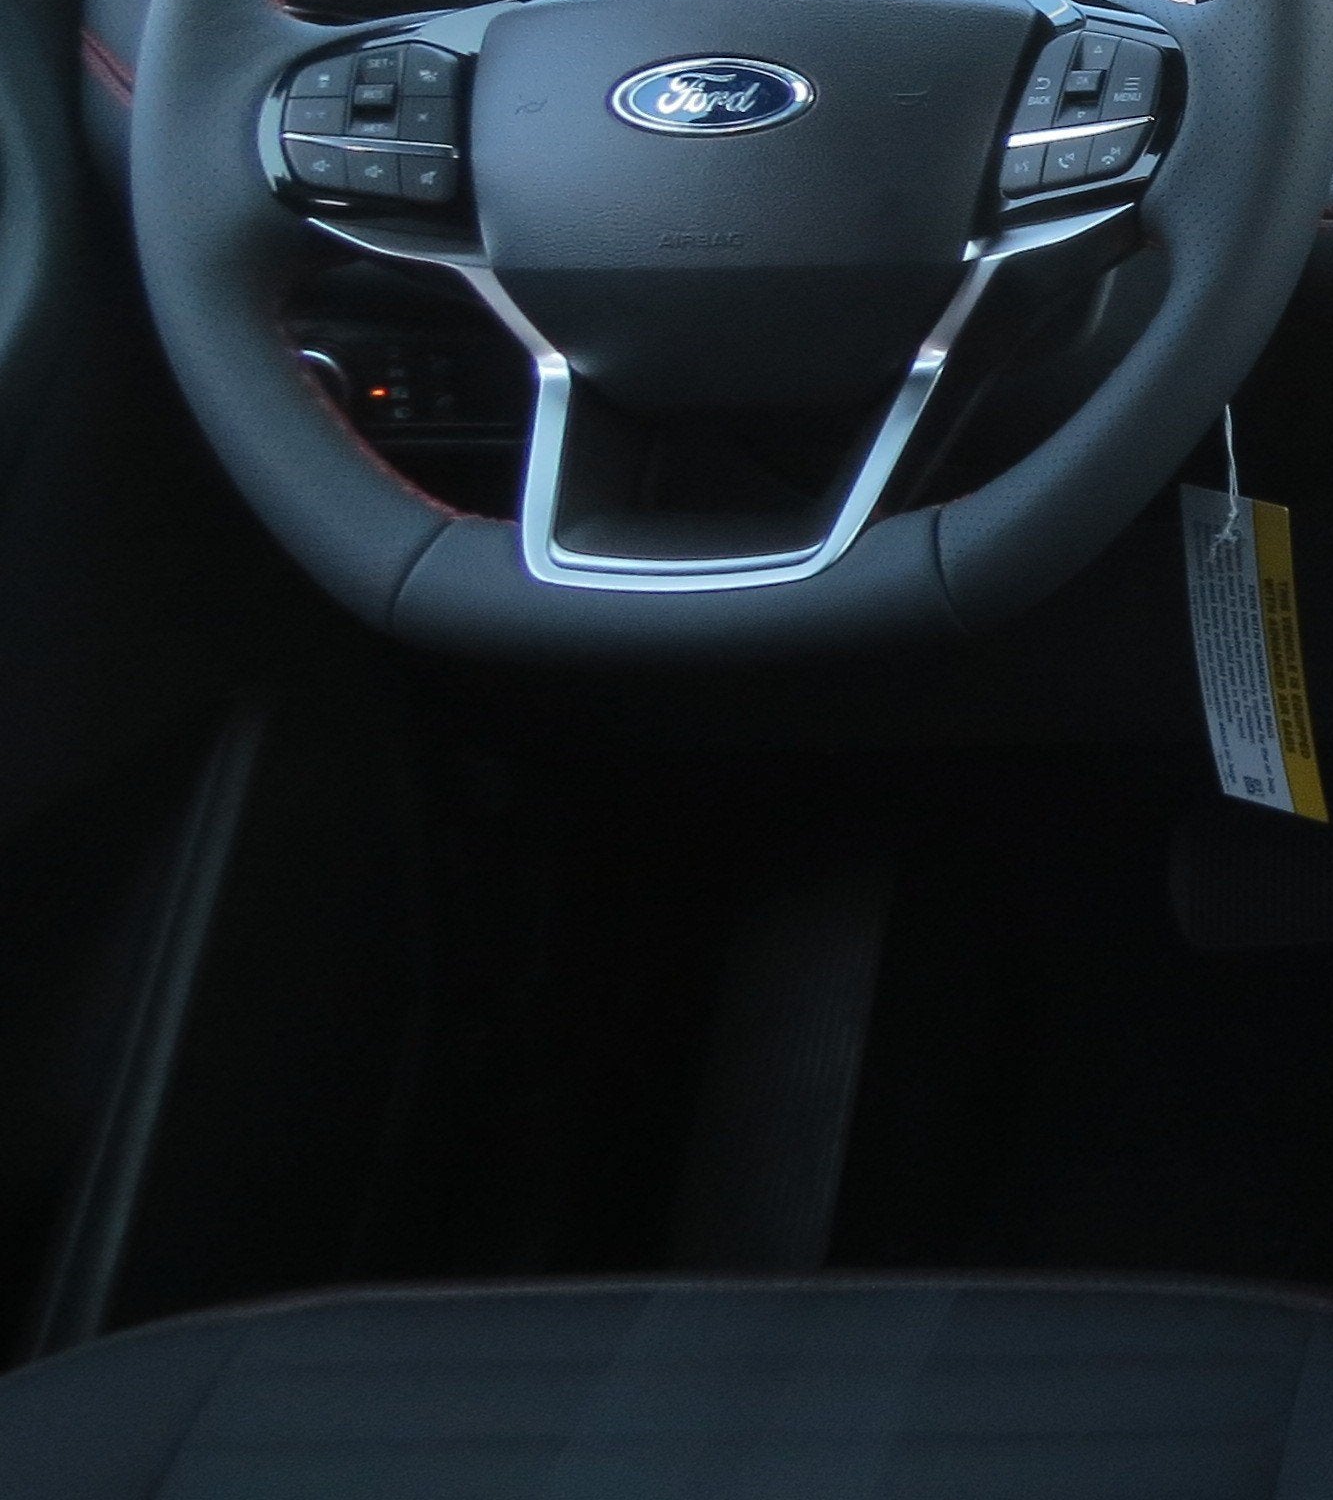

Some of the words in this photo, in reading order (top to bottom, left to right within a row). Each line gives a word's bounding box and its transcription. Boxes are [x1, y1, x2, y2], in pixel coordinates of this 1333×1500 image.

[656, 72, 760, 115] Ford
[1113, 92, 1142, 102] MENU
[1027, 95, 1052, 106] BACK
